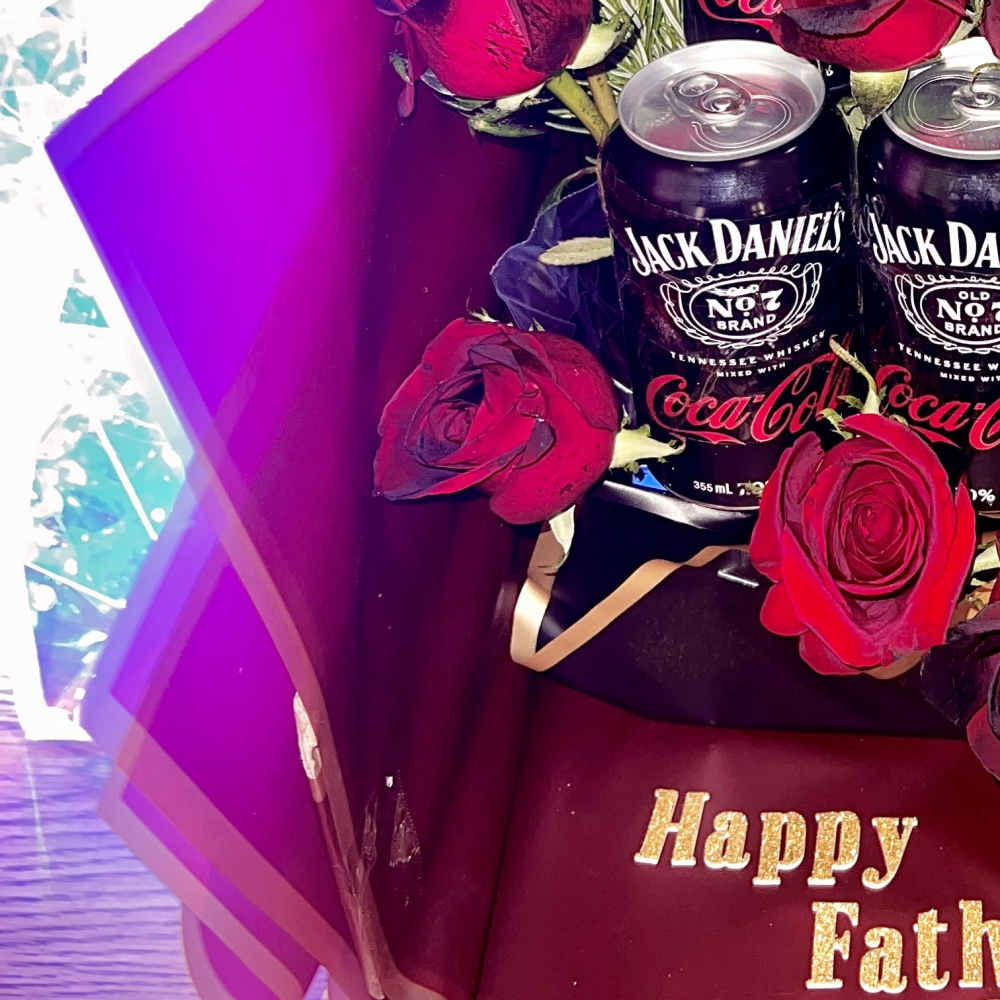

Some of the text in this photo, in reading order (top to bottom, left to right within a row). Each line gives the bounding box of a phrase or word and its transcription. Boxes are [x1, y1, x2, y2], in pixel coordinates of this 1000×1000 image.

[625, 201, 846, 277] JACK DANIEL'S
[869, 212, 946, 266] JACK
[958, 290, 990, 301] OLD
[716, 314, 777, 332] BRAND
[670, 329, 826, 367] TENNESSEE WHISKEY
[898, 342, 981, 371] TENNESSEE
[716, 362, 786, 378] MIXED WITH
[940, 372, 975, 382] MIXED
[693, 480, 713, 493] 355
[634, 788, 918, 890] Happy
